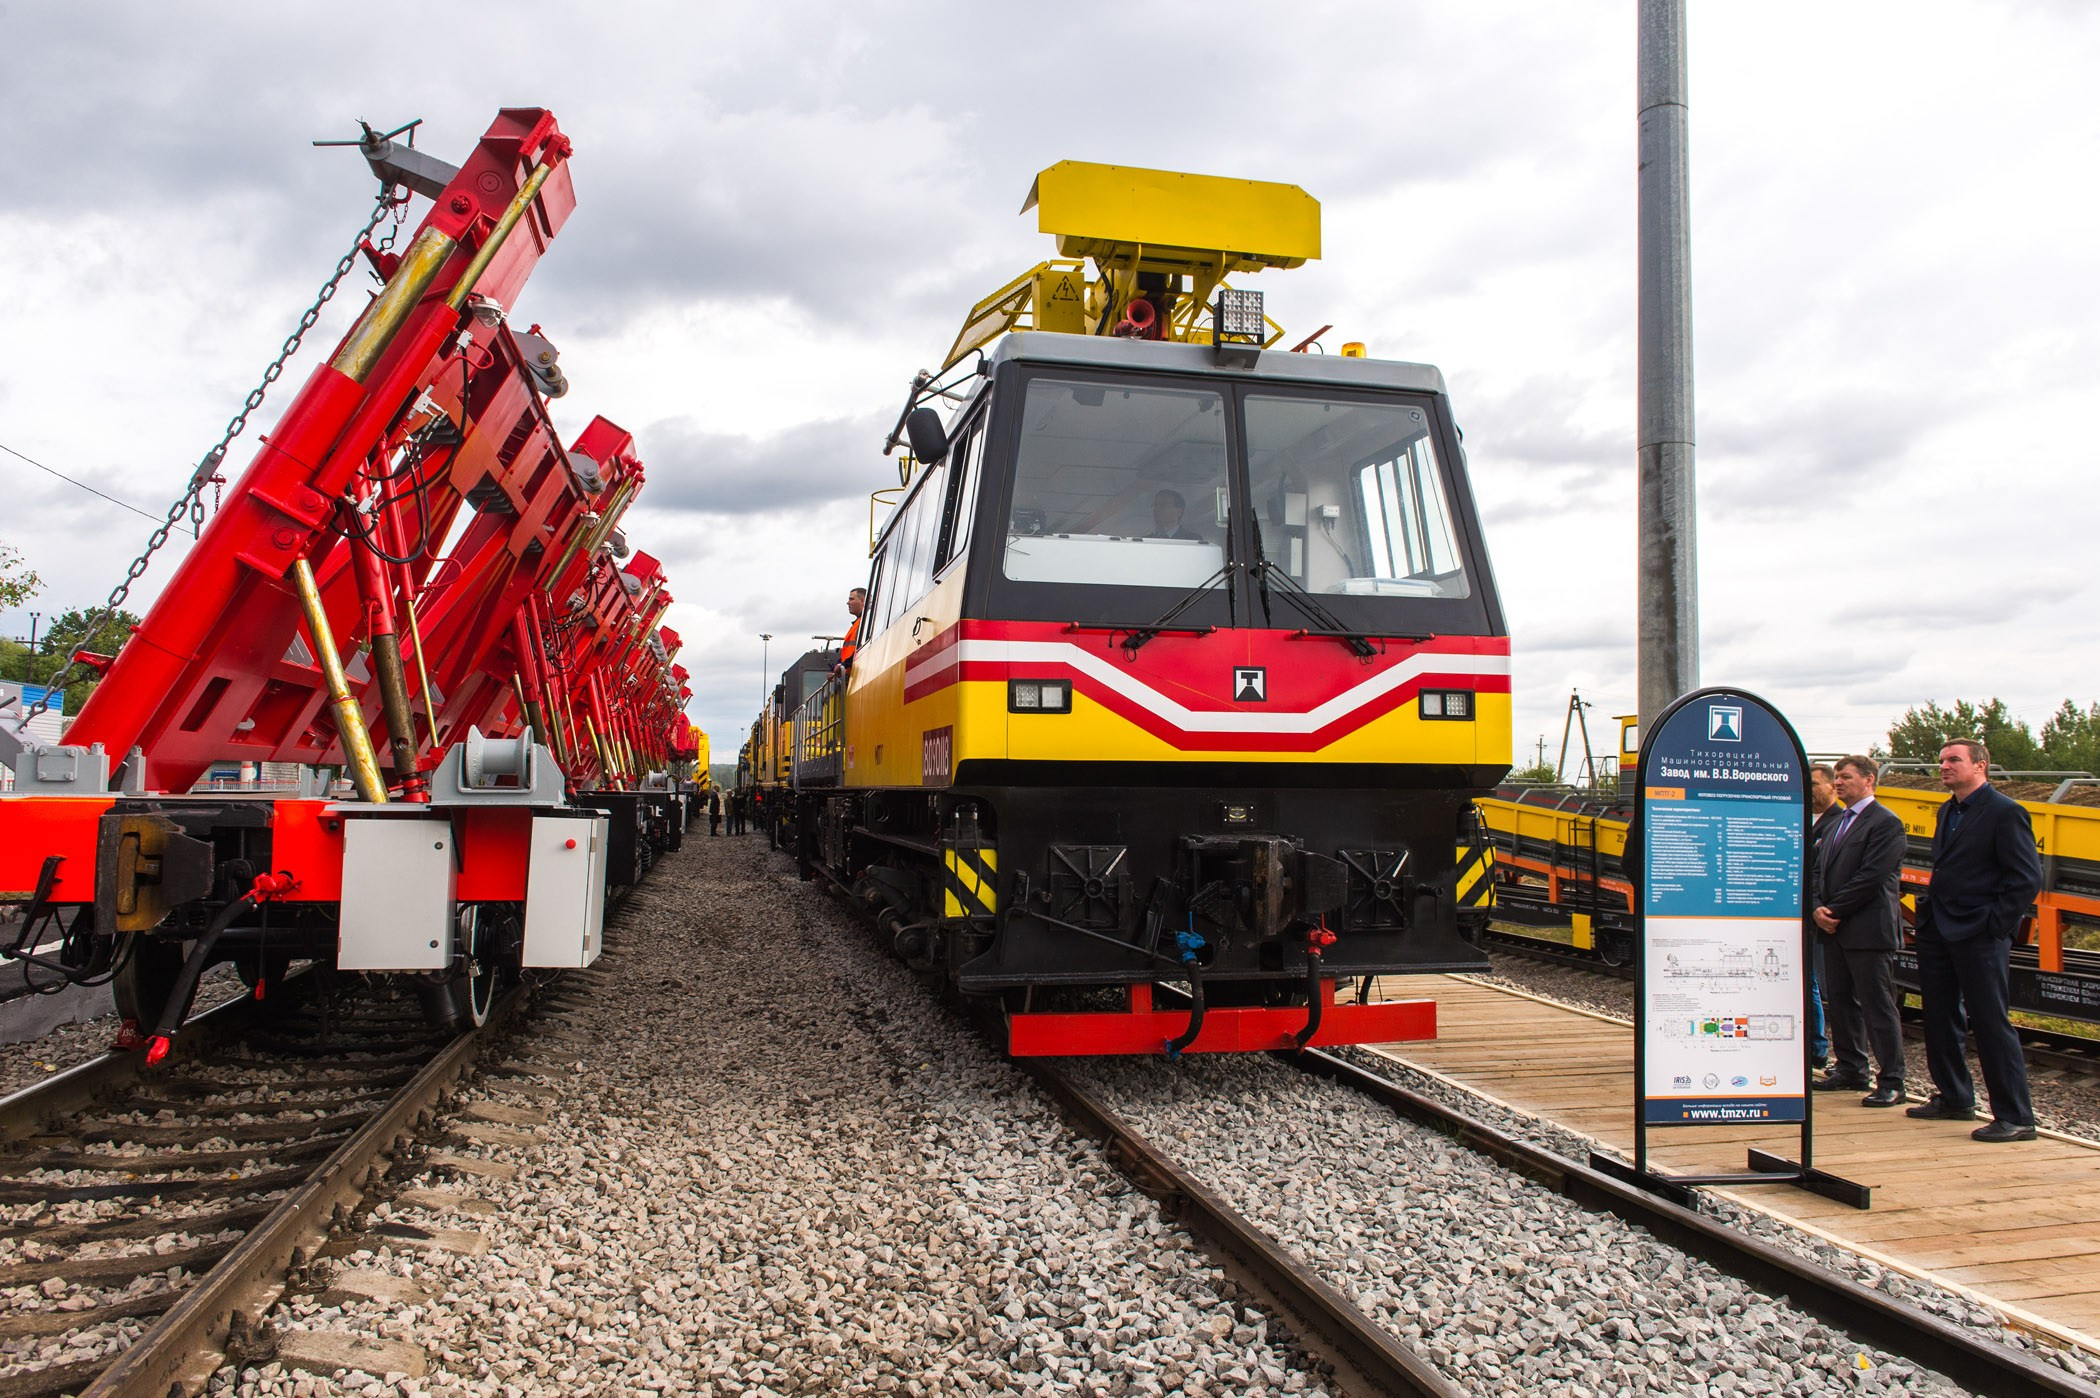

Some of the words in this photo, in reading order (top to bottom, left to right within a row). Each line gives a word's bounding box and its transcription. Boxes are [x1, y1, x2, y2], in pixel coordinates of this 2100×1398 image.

[1690, 749, 1760, 760] Тихорецкий
[1661, 757, 1790, 769] Машиностроительный
[1660, 766, 1690, 779] Завод
[1694, 769, 1710, 779] им.
[1712, 768, 1789, 782] В.В.Воровского
[1690, 1107, 1760, 1119] www.tmzv.ru
